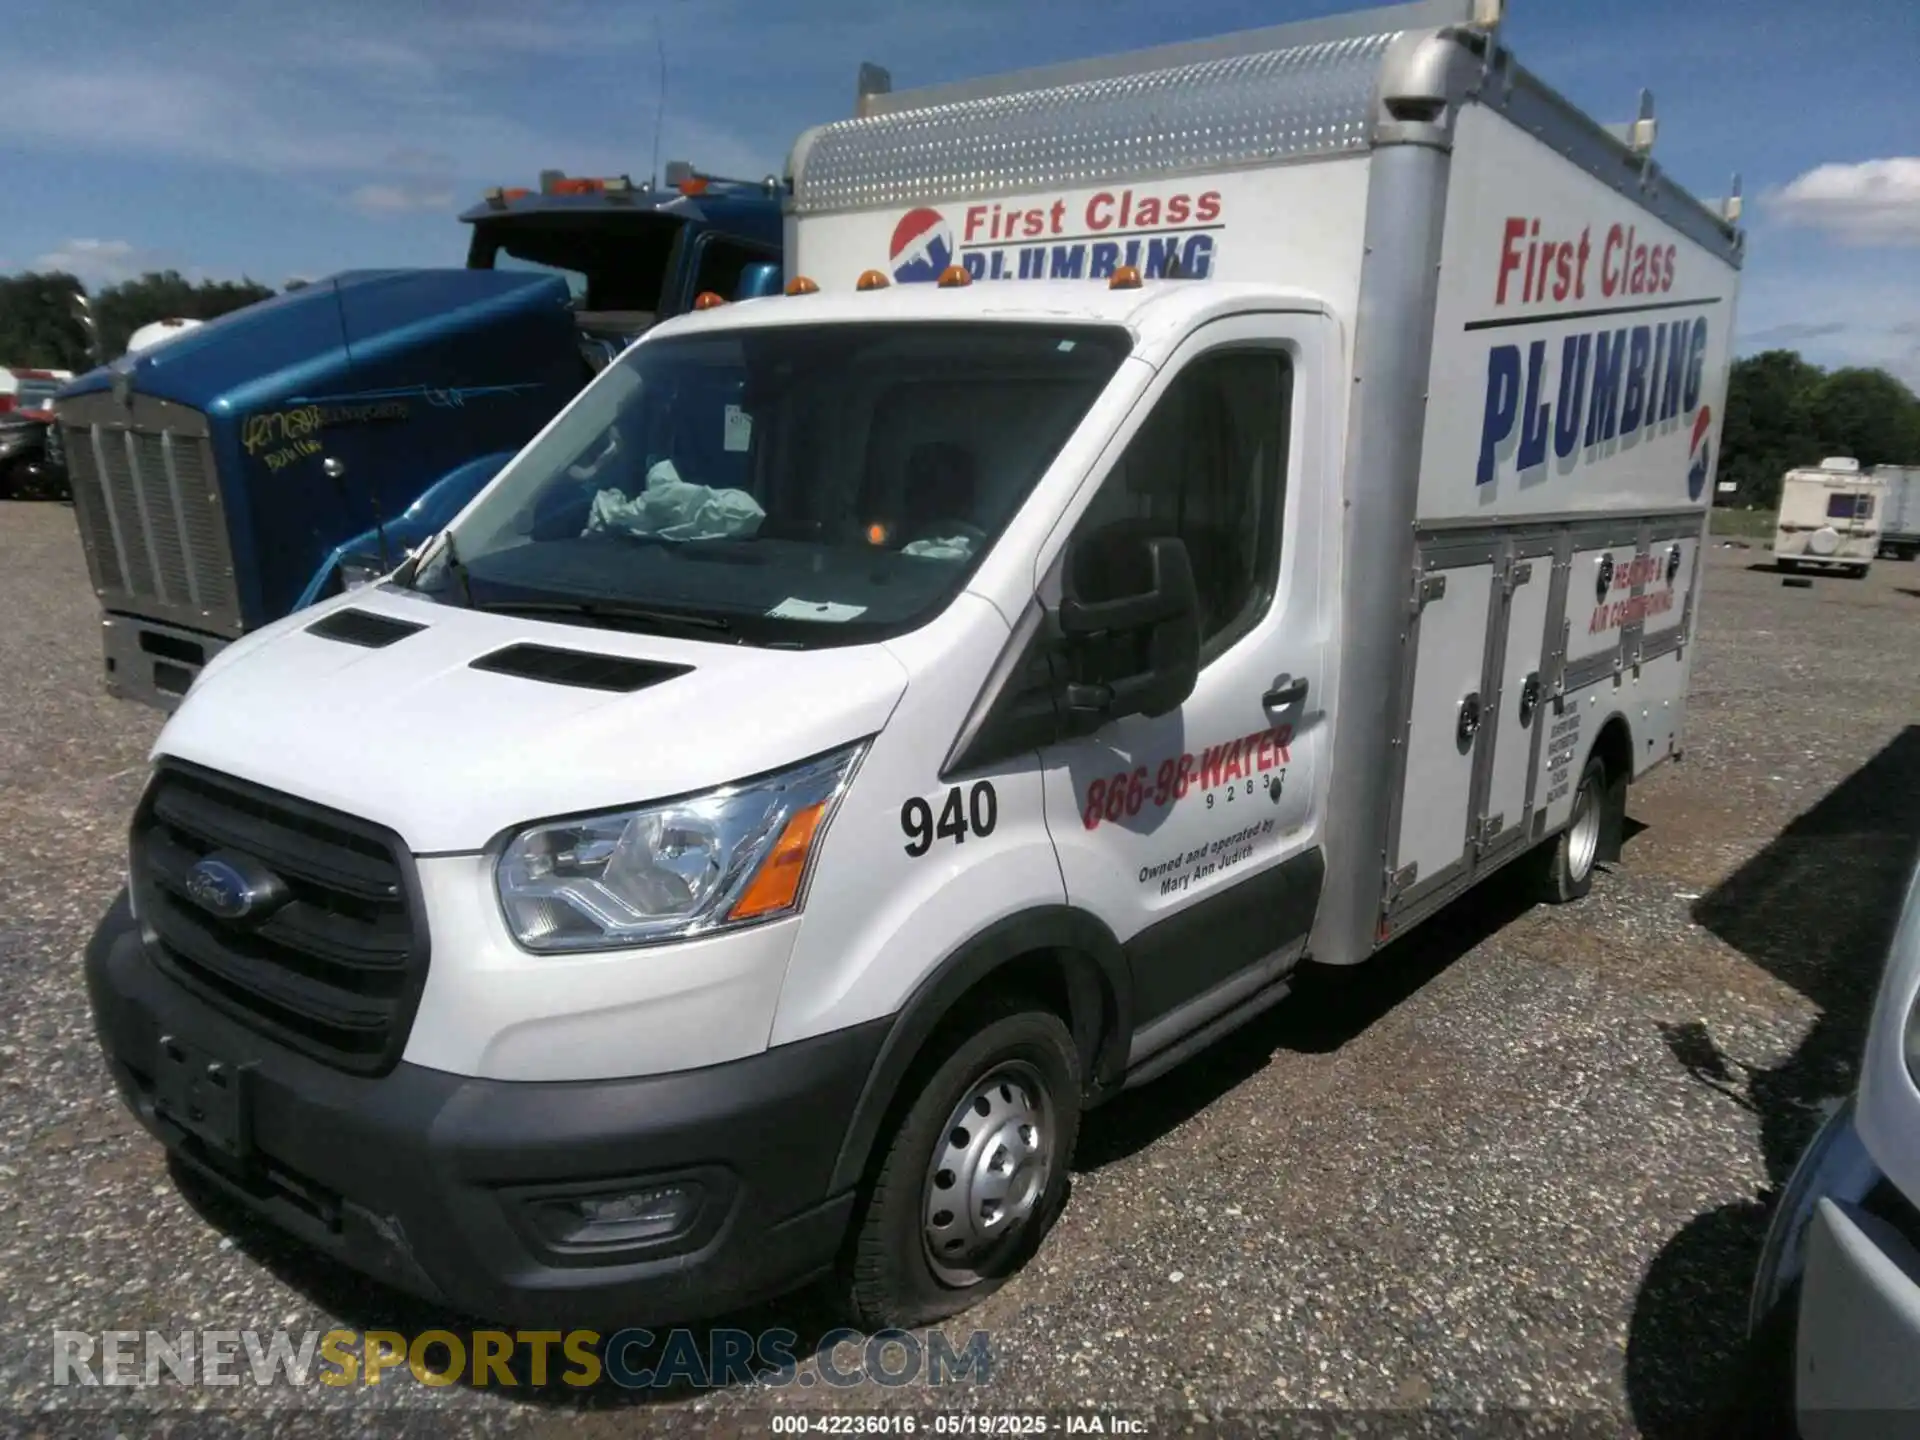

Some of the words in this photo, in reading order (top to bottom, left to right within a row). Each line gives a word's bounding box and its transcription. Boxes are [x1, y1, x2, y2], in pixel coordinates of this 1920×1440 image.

[963, 199, 1066, 242] First
[1085, 189, 1222, 232] Class
[1494, 216, 1590, 305] First
[1602, 222, 1676, 298] Class
[1475, 315, 1708, 486] PLUMBING
[1588, 604, 1609, 635] AIR
[1083, 724, 1294, 831] 866-98-WATER
[900, 780, 998, 858] 940
[1139, 853, 1184, 883] Owned
[1185, 842, 1209, 864] and
[1210, 820, 1261, 855] operated
[1261, 819, 1276, 834] by
[1160, 873, 1190, 897] Mary
[1193, 862, 1216, 882] Ann
